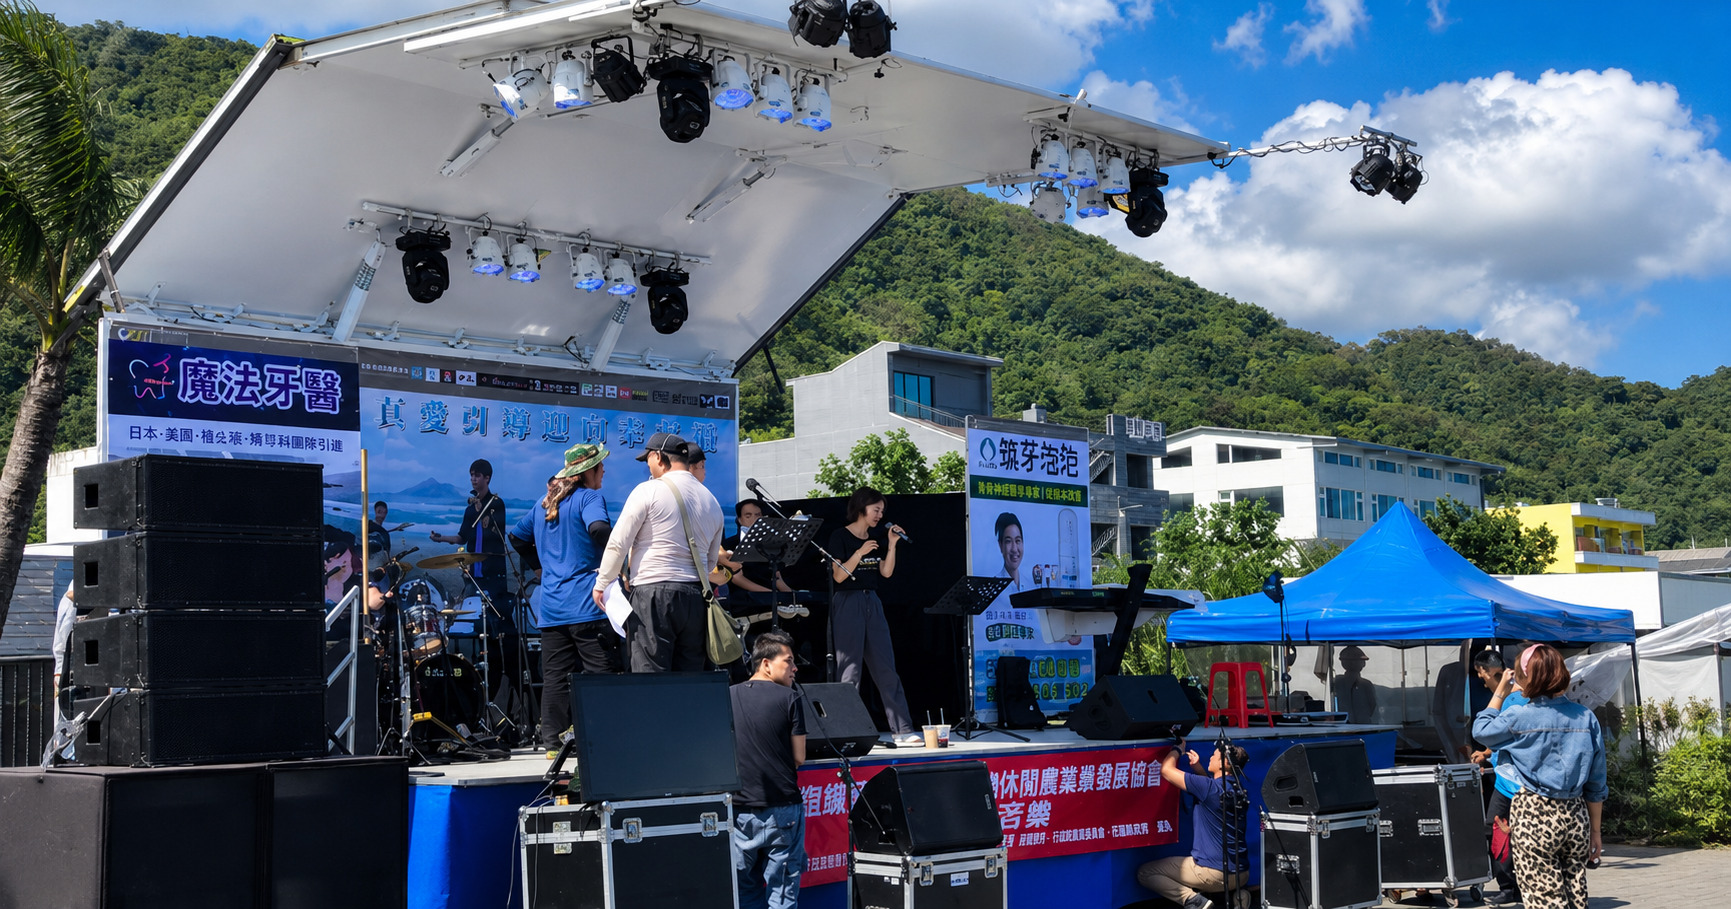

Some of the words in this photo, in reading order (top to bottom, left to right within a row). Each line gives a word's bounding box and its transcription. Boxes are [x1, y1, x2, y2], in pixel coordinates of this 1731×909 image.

[177, 357, 342, 414] 魔法牙醫
[998, 799, 1052, 831] 音樂
